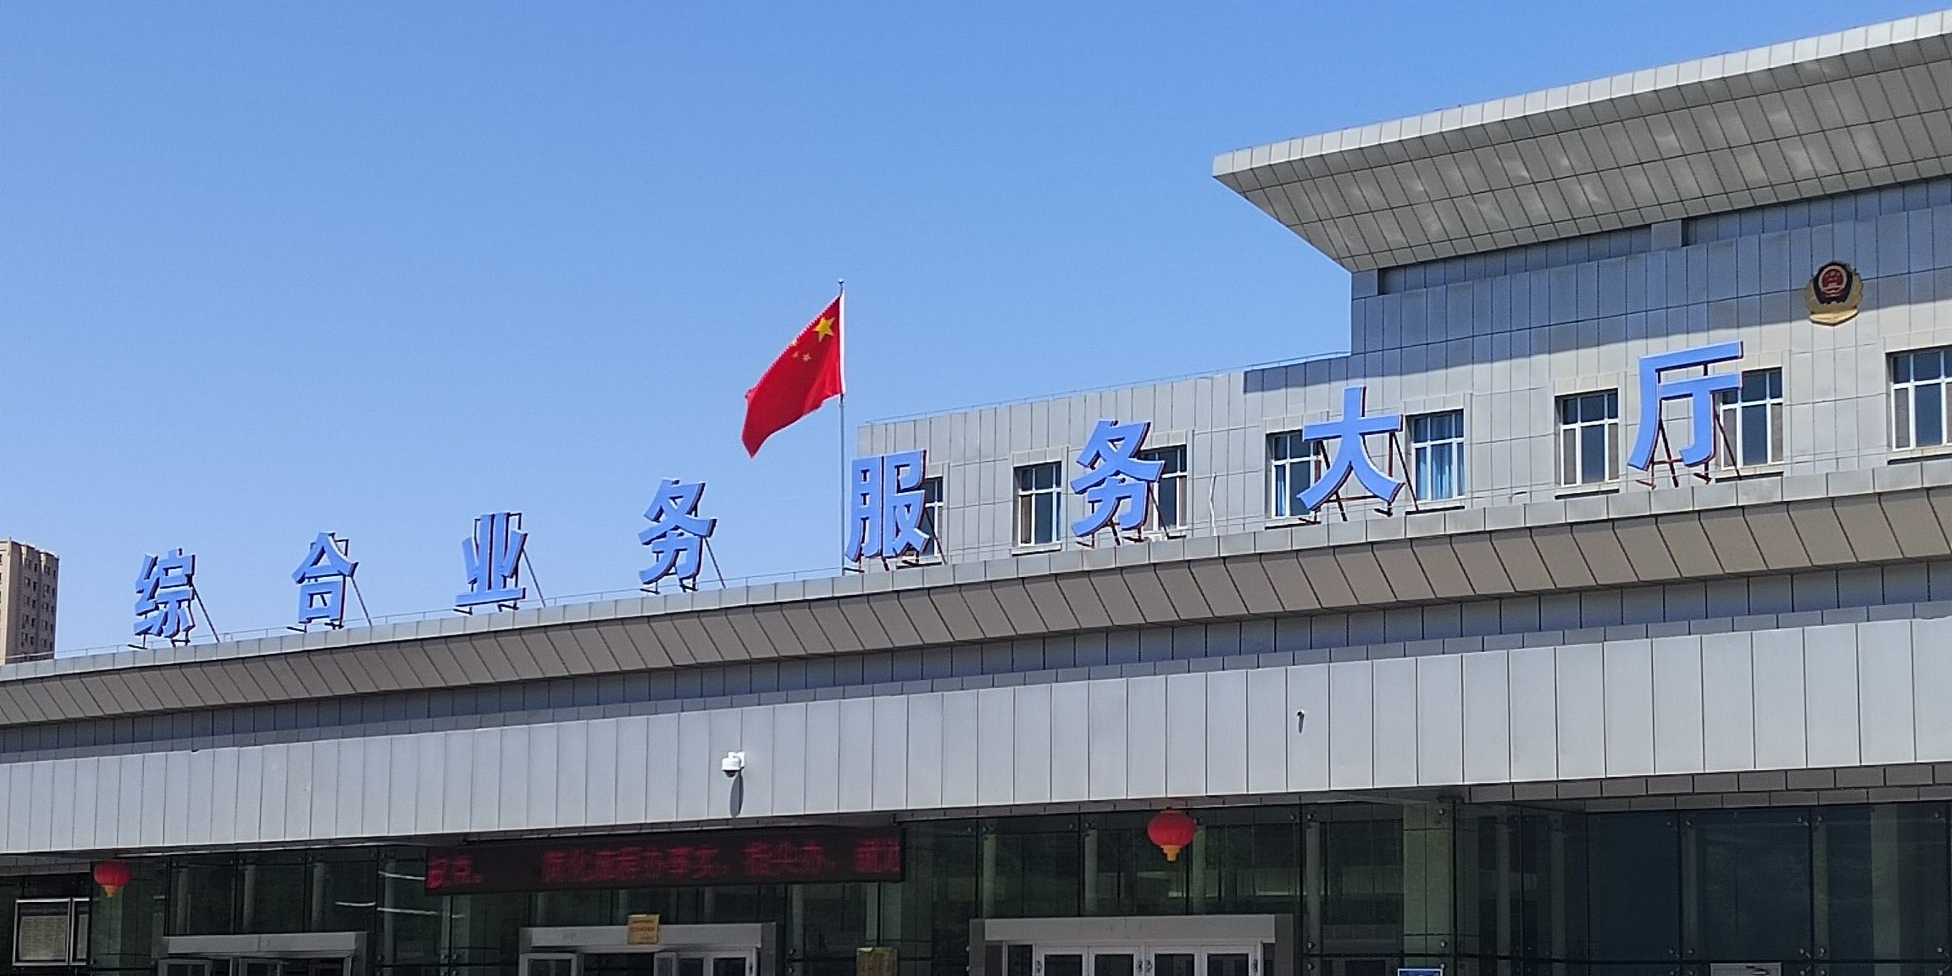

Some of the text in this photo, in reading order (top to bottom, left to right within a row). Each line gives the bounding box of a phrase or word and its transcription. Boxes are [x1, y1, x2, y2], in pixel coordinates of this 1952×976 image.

[134, 342, 1743, 637] 综合业务服务大厅
